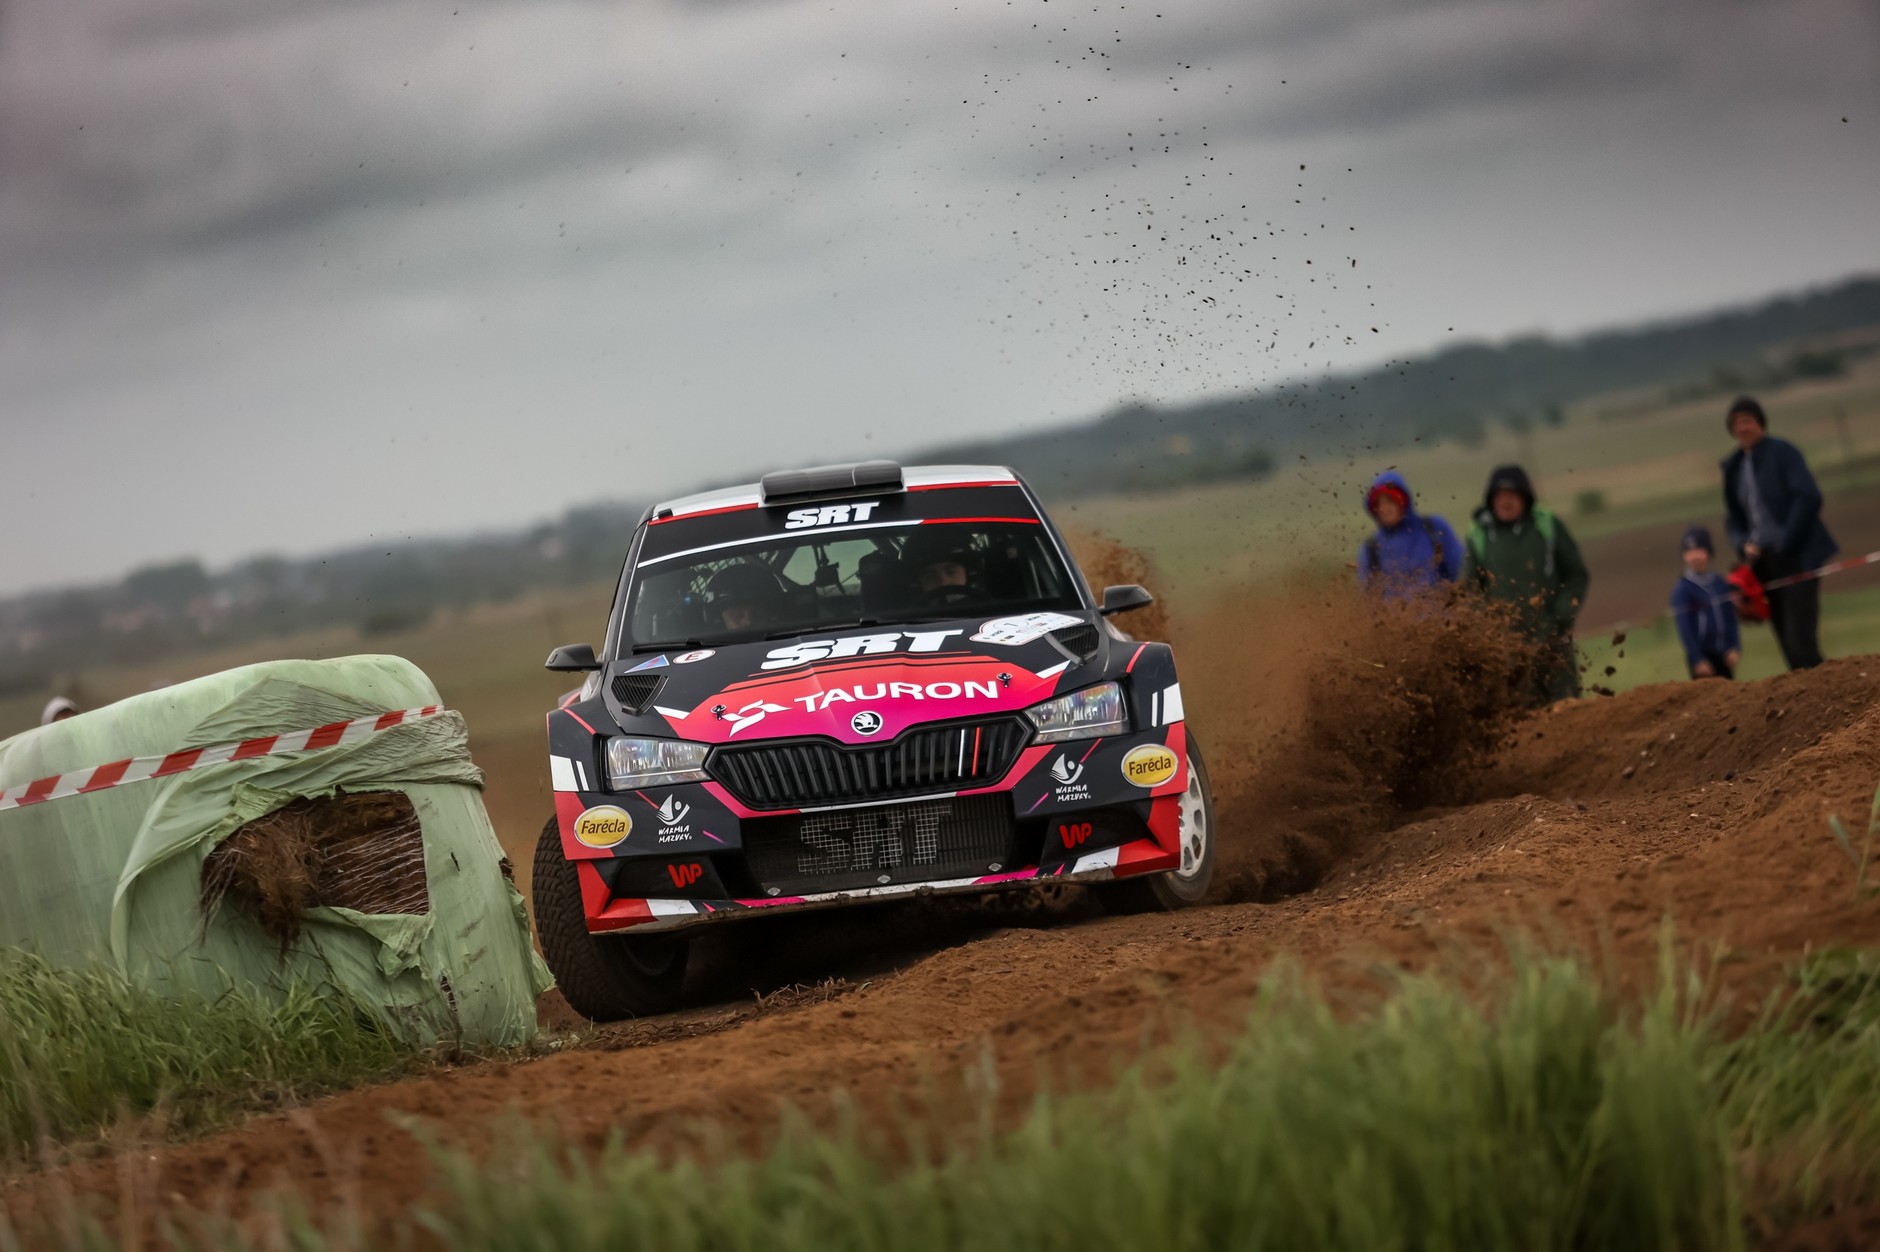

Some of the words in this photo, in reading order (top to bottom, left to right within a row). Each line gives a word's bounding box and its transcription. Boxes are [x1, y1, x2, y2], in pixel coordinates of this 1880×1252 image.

[785, 501, 880, 530] SRT
[761, 629, 964, 670] SRT
[794, 680, 999, 714] TAURON
[1128, 756, 1172, 776] Farécla
[581, 819, 626, 835] Farécla
[797, 804, 953, 875] SRT
[1059, 822, 1093, 849] WP
[668, 864, 702, 888] WP
